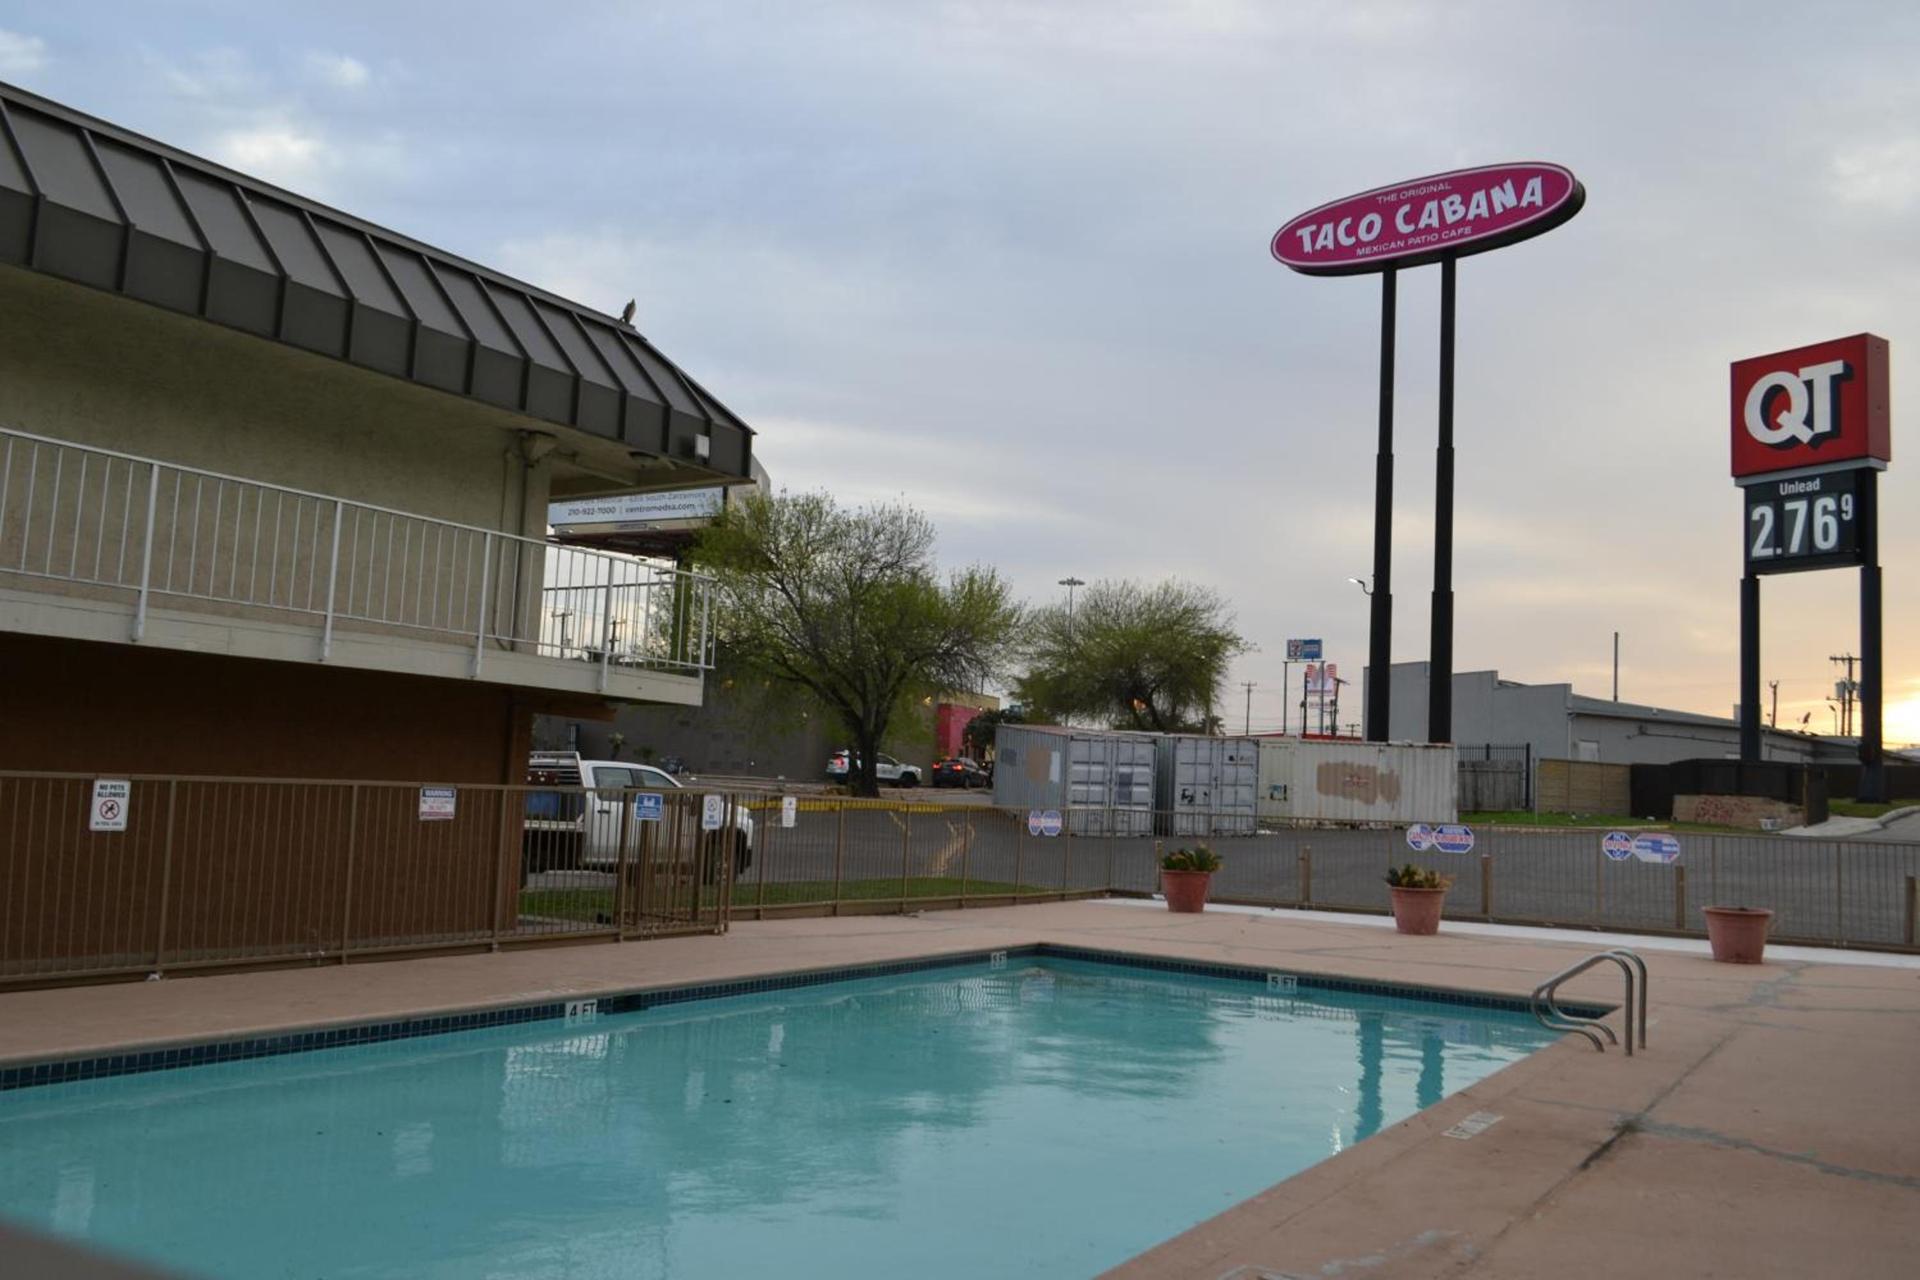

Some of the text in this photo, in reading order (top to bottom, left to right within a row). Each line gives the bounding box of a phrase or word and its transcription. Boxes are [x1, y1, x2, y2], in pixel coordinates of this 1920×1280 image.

[1376, 182, 1452, 204] THE ORIGINAL
[1297, 175, 1543, 254] TACO CABANA
[1356, 226, 1472, 256] MEXICAN PATIO CAFE
[1744, 359, 1848, 446] QT
[1779, 478, 1821, 496] Unlead
[568, 506, 616, 516] 210-922-7000
[569, 1002, 596, 1016] 4 FT
